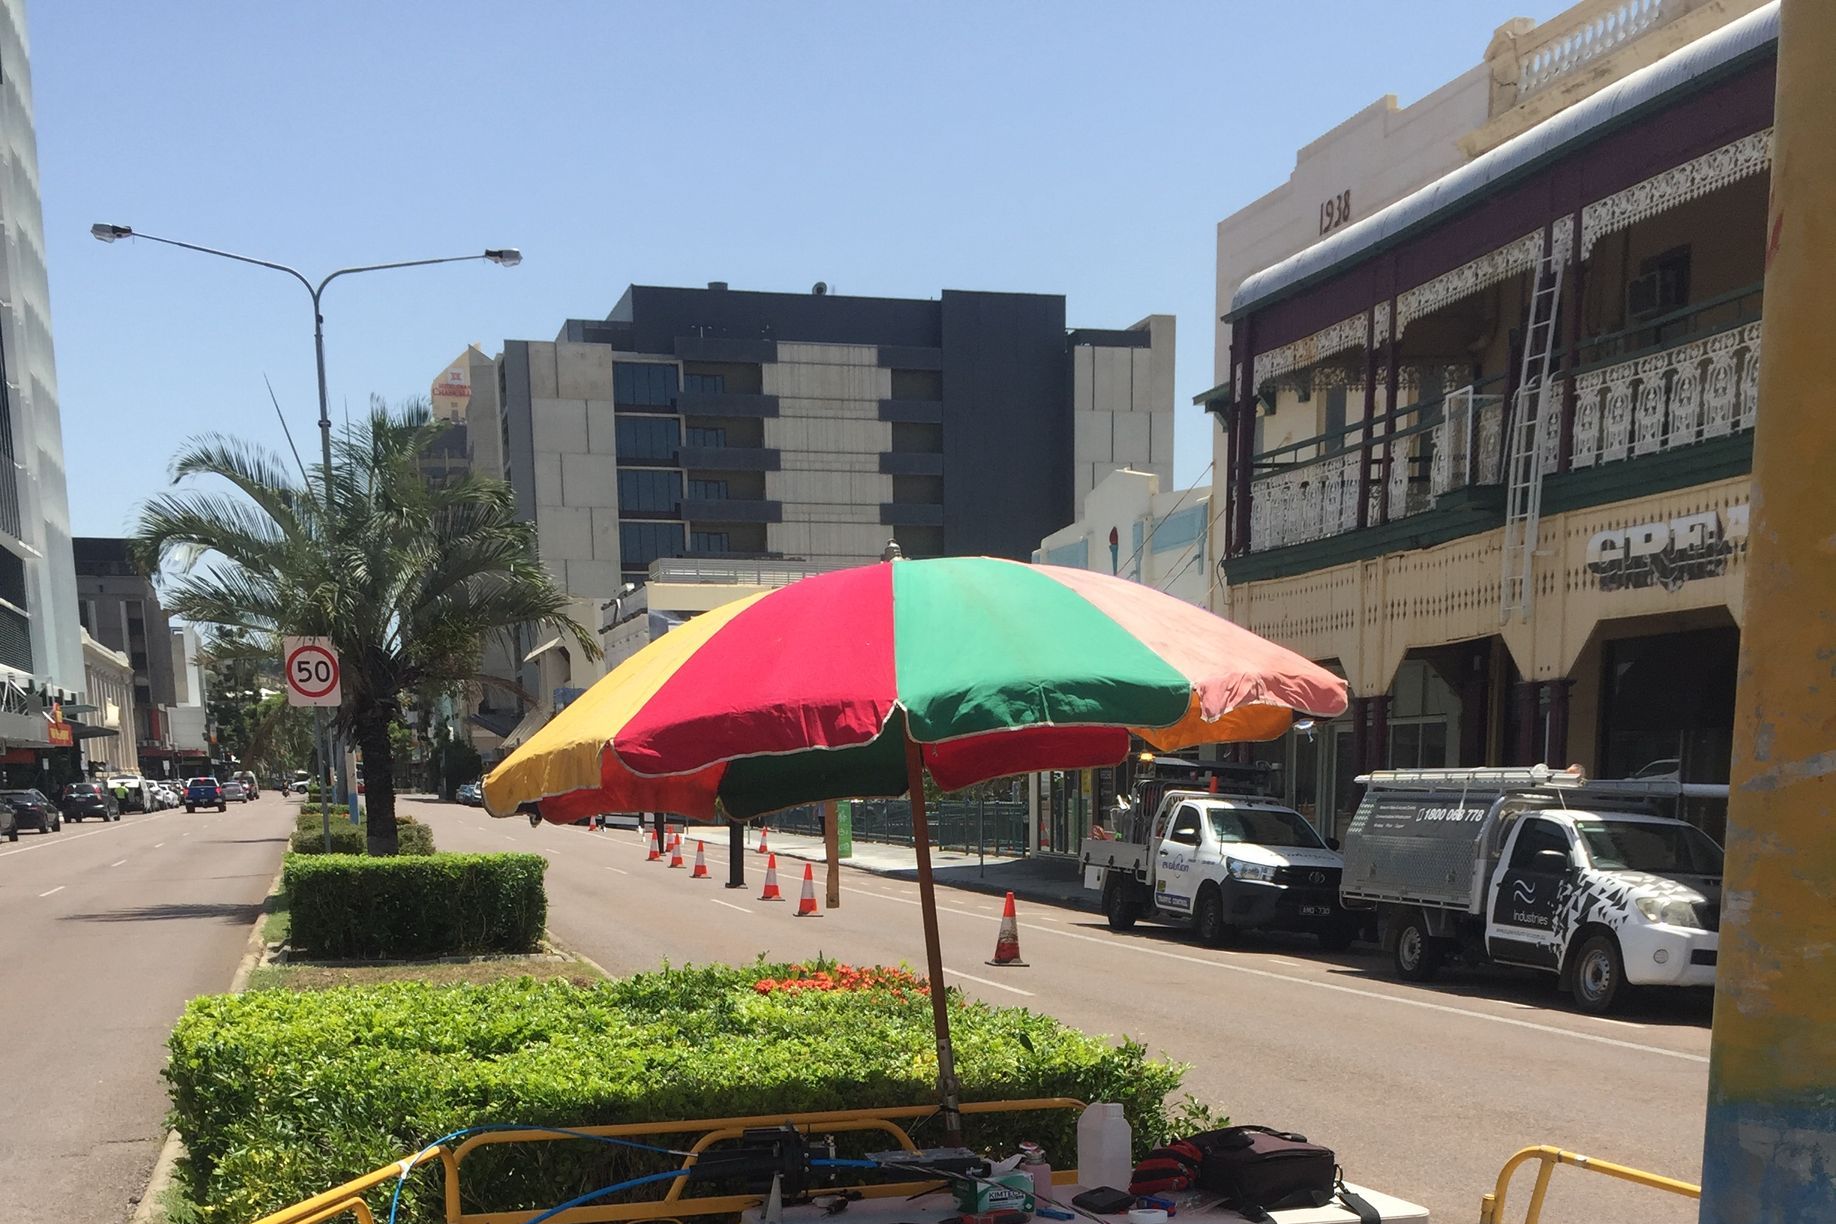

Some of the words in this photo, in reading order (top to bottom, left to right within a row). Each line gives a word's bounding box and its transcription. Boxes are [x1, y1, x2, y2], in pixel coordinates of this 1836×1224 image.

[1319, 189, 1350, 236] 1938
[297, 660, 330, 683] 50
[1423, 808, 1446, 820] 1800
[1465, 809, 1485, 821] 778
[1514, 909, 1549, 925] Industries
